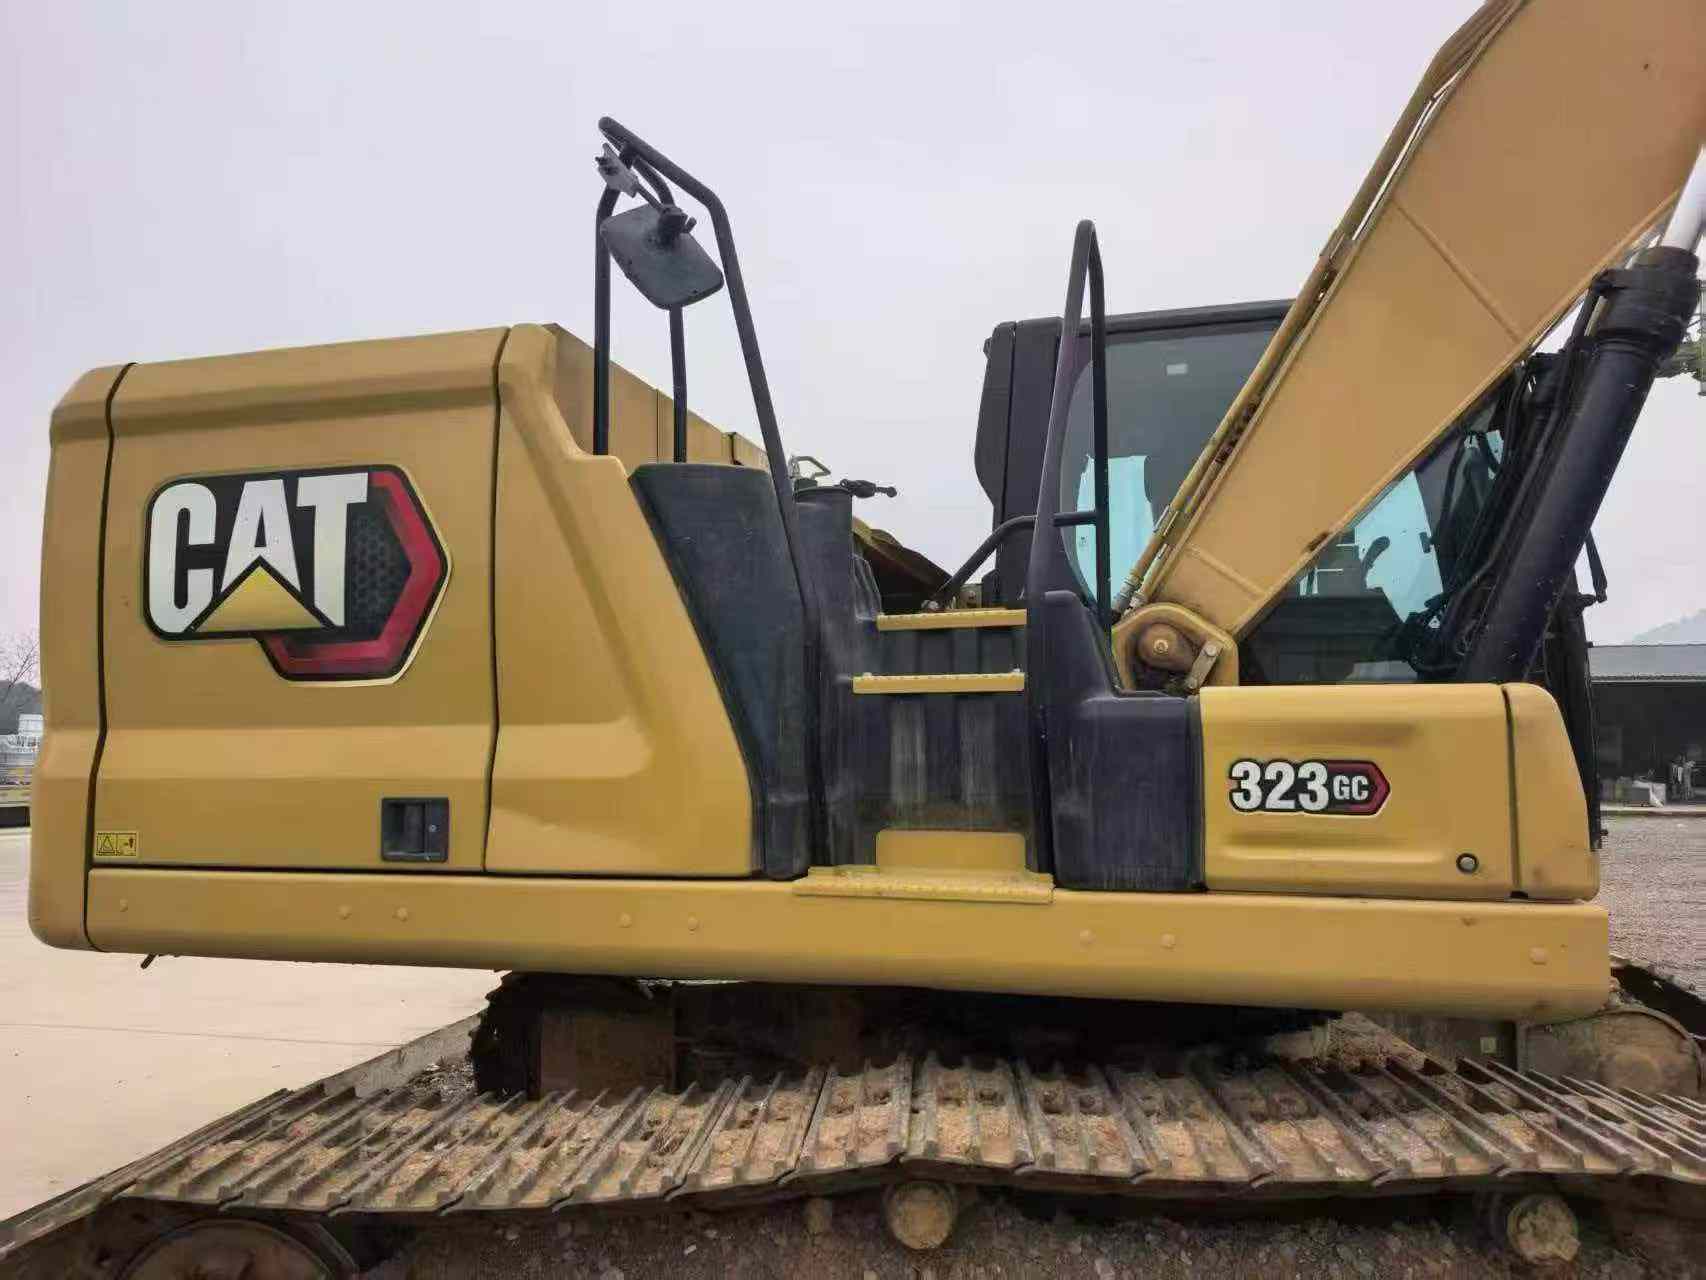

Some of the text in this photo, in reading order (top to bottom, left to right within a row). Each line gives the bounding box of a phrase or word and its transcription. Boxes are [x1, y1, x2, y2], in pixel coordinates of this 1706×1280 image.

[149, 472, 368, 633] CAT
[1231, 761, 1369, 811] 323 GC
